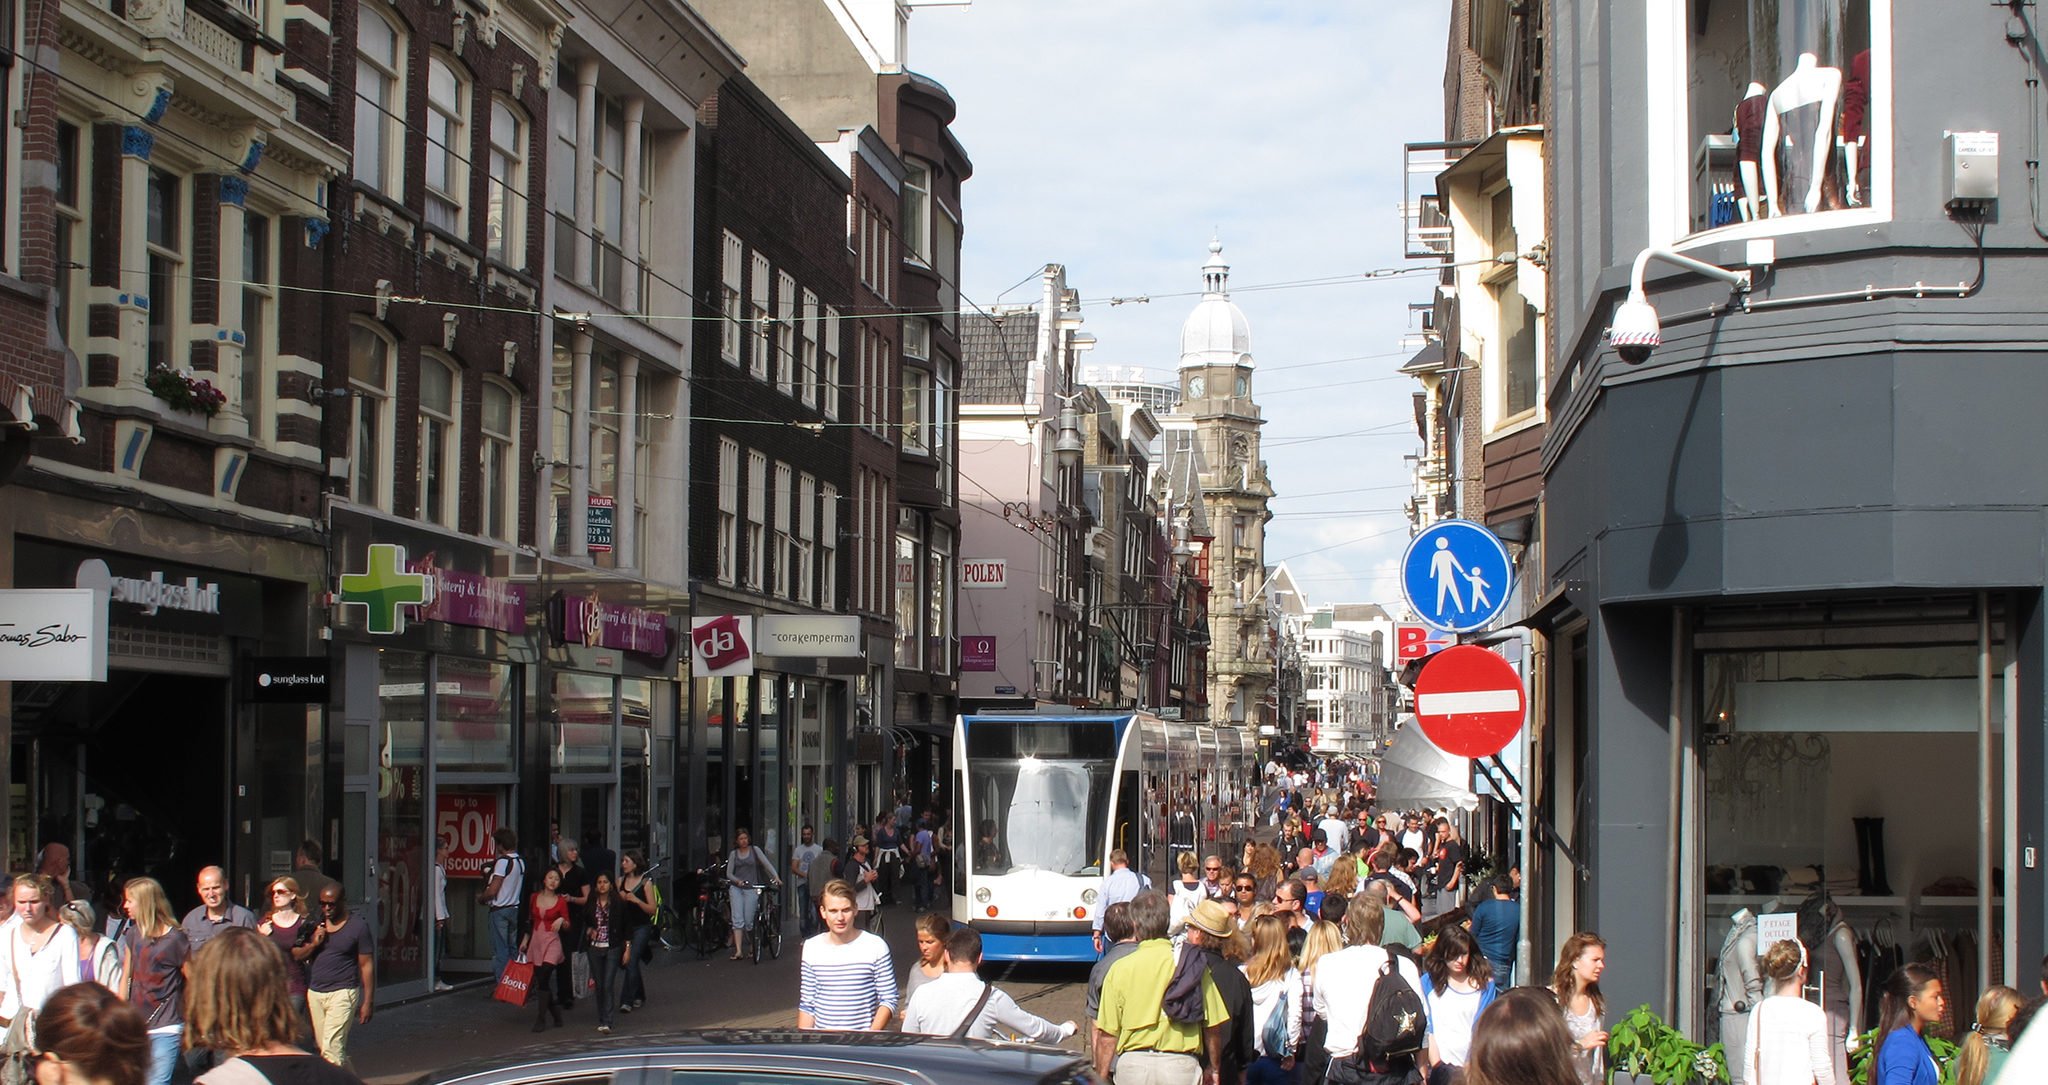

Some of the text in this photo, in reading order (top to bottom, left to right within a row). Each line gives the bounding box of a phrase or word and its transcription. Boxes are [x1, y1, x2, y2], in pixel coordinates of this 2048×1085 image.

[1084, 366, 1145, 381] ETZ
[591, 498, 612, 506] HUUR
[963, 563, 1005, 583] POLEN
[110, 571, 188, 616] sunglass
[467, 581, 476, 596] &
[28, 624, 87, 647] Sabo
[699, 628, 735, 659] da
[272, 673, 325, 687] sunglass hut
[454, 798, 478, 809] up to
[437, 811, 496, 856] 50%
[444, 857, 495, 871] ISCOUN
[1764, 930, 1790, 938] OUTLET
[401, 946, 418, 961] OFF
[501, 974, 528, 991] Boots
